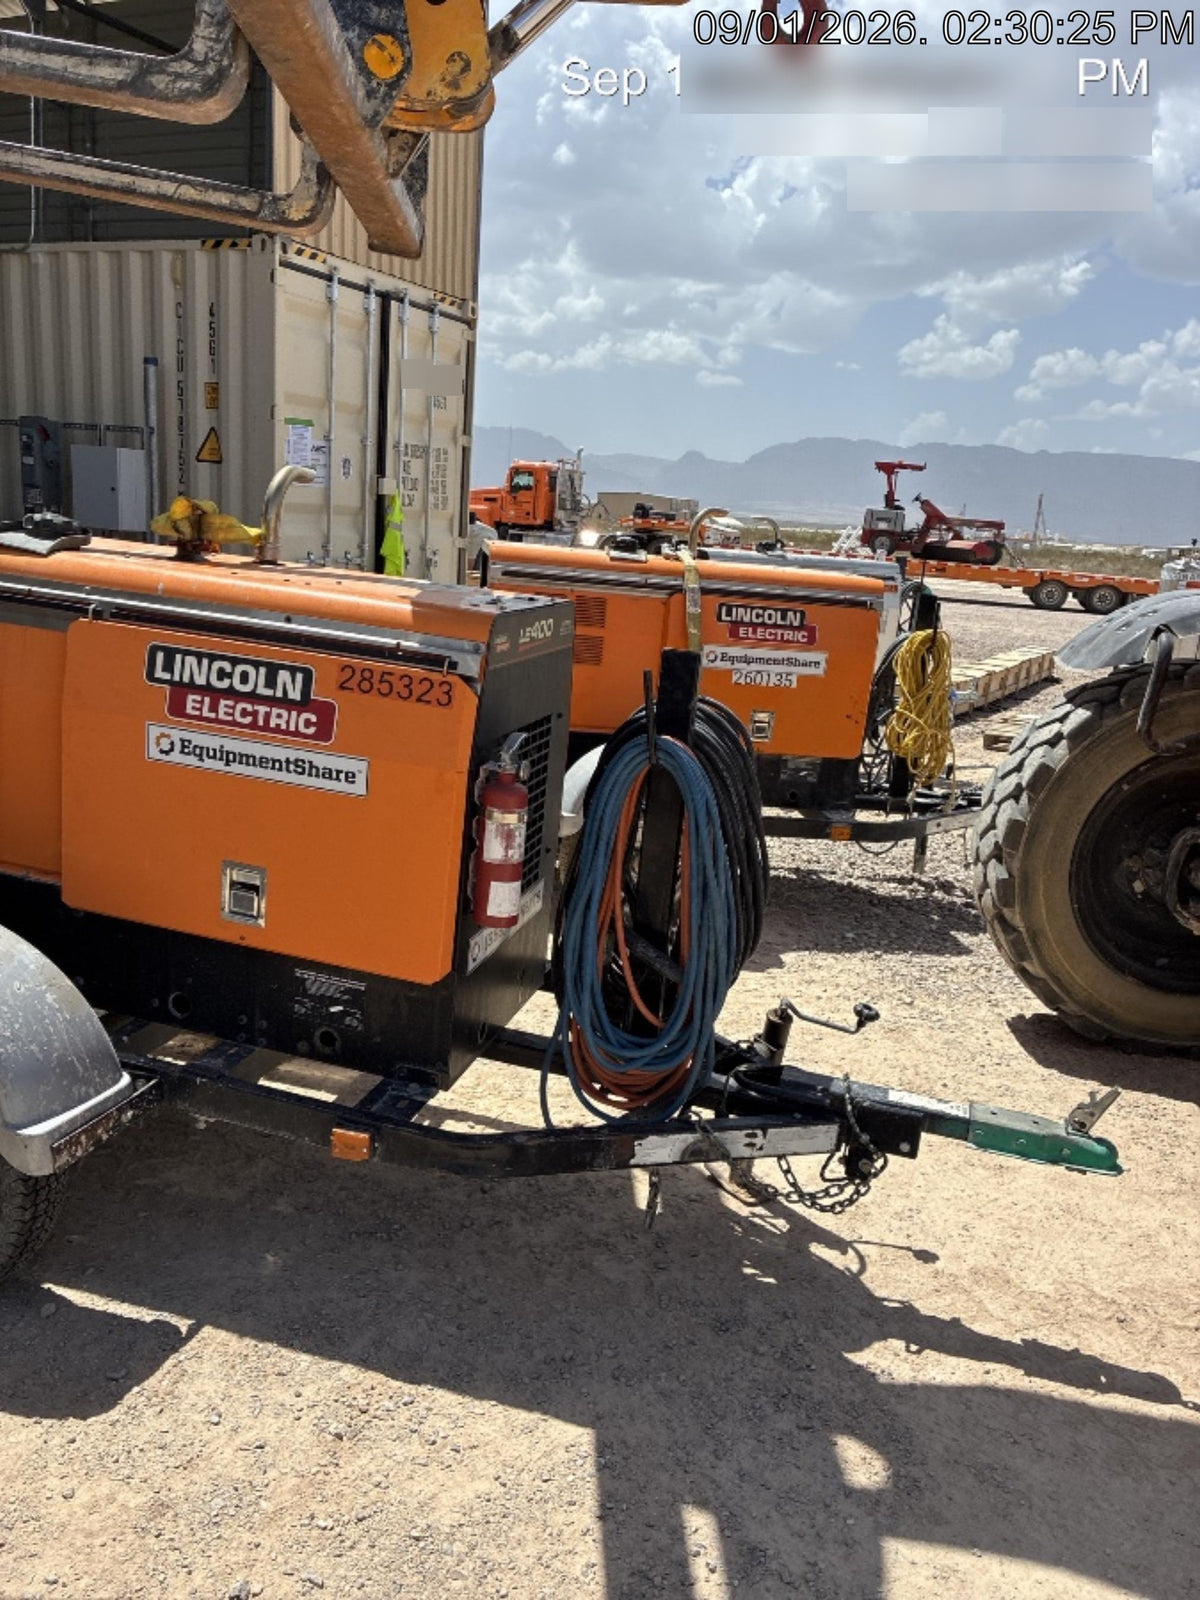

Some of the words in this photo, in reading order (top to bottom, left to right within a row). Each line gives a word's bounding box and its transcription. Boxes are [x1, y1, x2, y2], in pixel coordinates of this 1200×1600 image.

[720, 605, 801, 627] LINCOLN
[738, 626, 809, 643] ELECTRIC
[153, 650, 304, 702] LINCOLN
[719, 651, 821, 669] EquipmentShare
[338, 664, 453, 707] 285323
[733, 670, 794, 687] 260135
[184, 693, 318, 735] ELECTRIC
[178, 737, 357, 785] EquipmentShare
